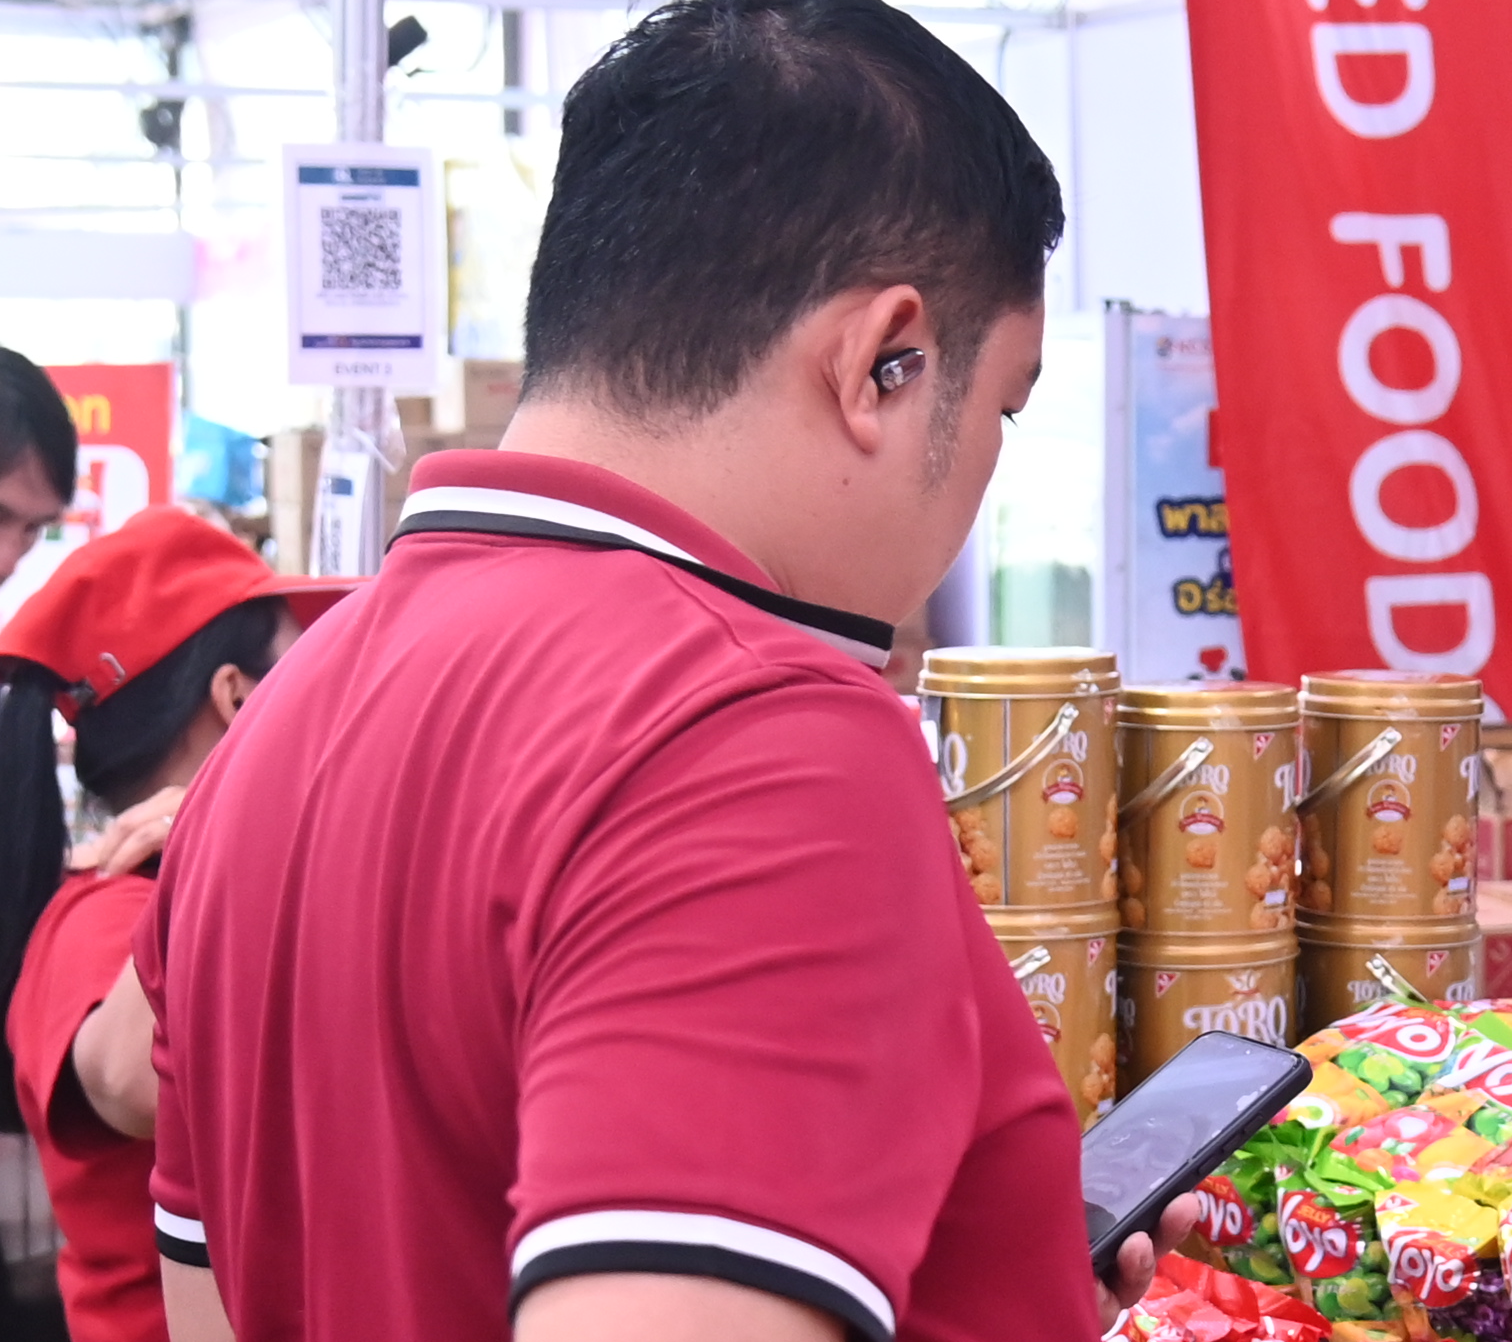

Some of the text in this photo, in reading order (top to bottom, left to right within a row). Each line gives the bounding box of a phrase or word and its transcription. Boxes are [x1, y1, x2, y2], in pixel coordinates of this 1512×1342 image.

[1329, 211, 1504, 724] FOOD
[1195, 1190, 1243, 1243] oyo
[1277, 1187, 1350, 1273] Yoyo
[1298, 1204, 1332, 1225] JELLY
